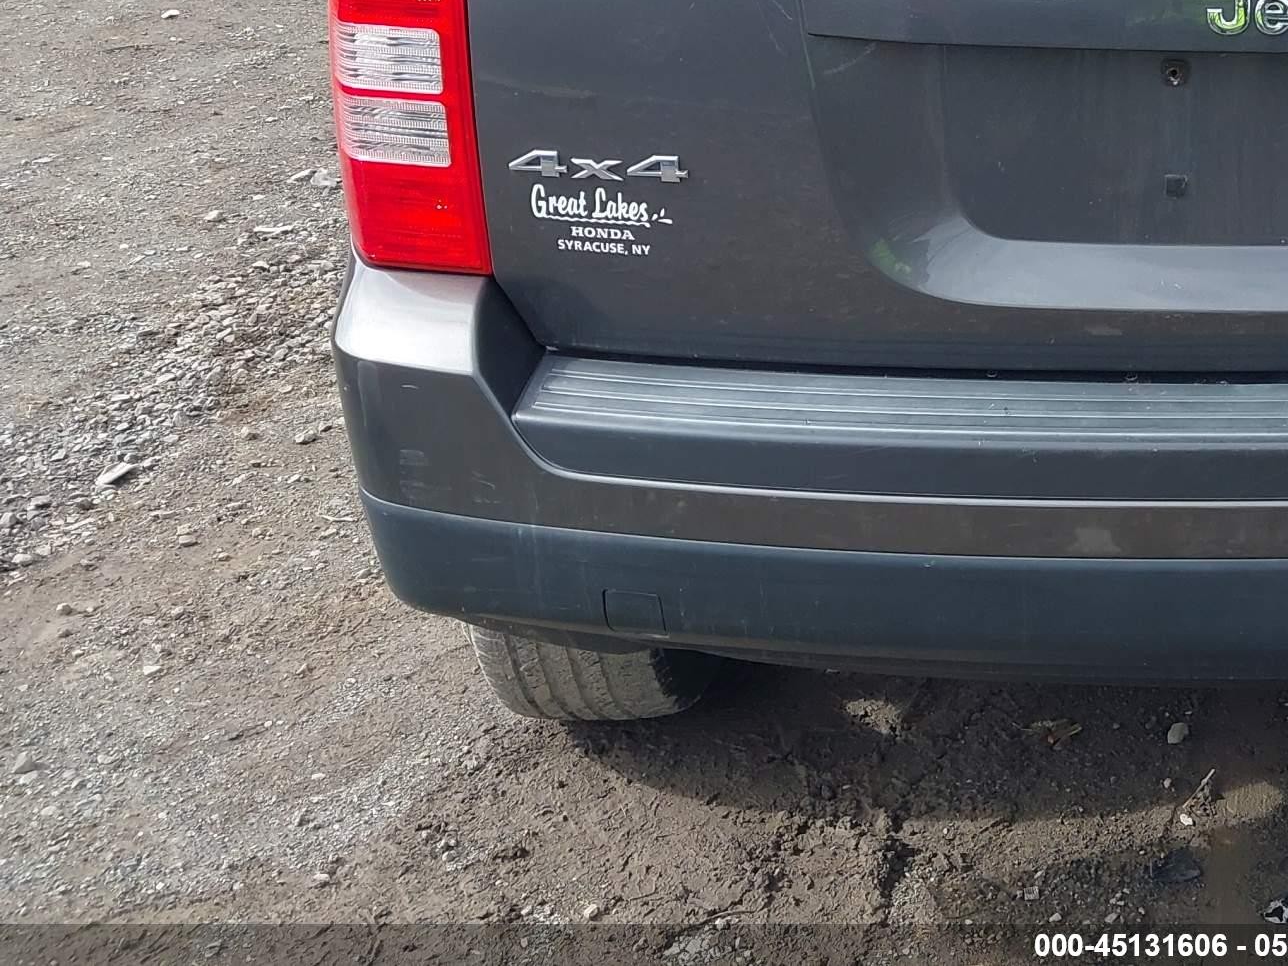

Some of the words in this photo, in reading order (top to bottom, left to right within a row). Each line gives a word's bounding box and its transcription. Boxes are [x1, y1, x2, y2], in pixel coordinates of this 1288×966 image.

[508, 148, 689, 183] 4x4
[530, 183, 588, 218] Great
[592, 187, 649, 221] Lakes
[570, 226, 635, 241] HONDA
[557, 239, 629, 255] SYRACUSE,
[632, 244, 651, 255] NY
